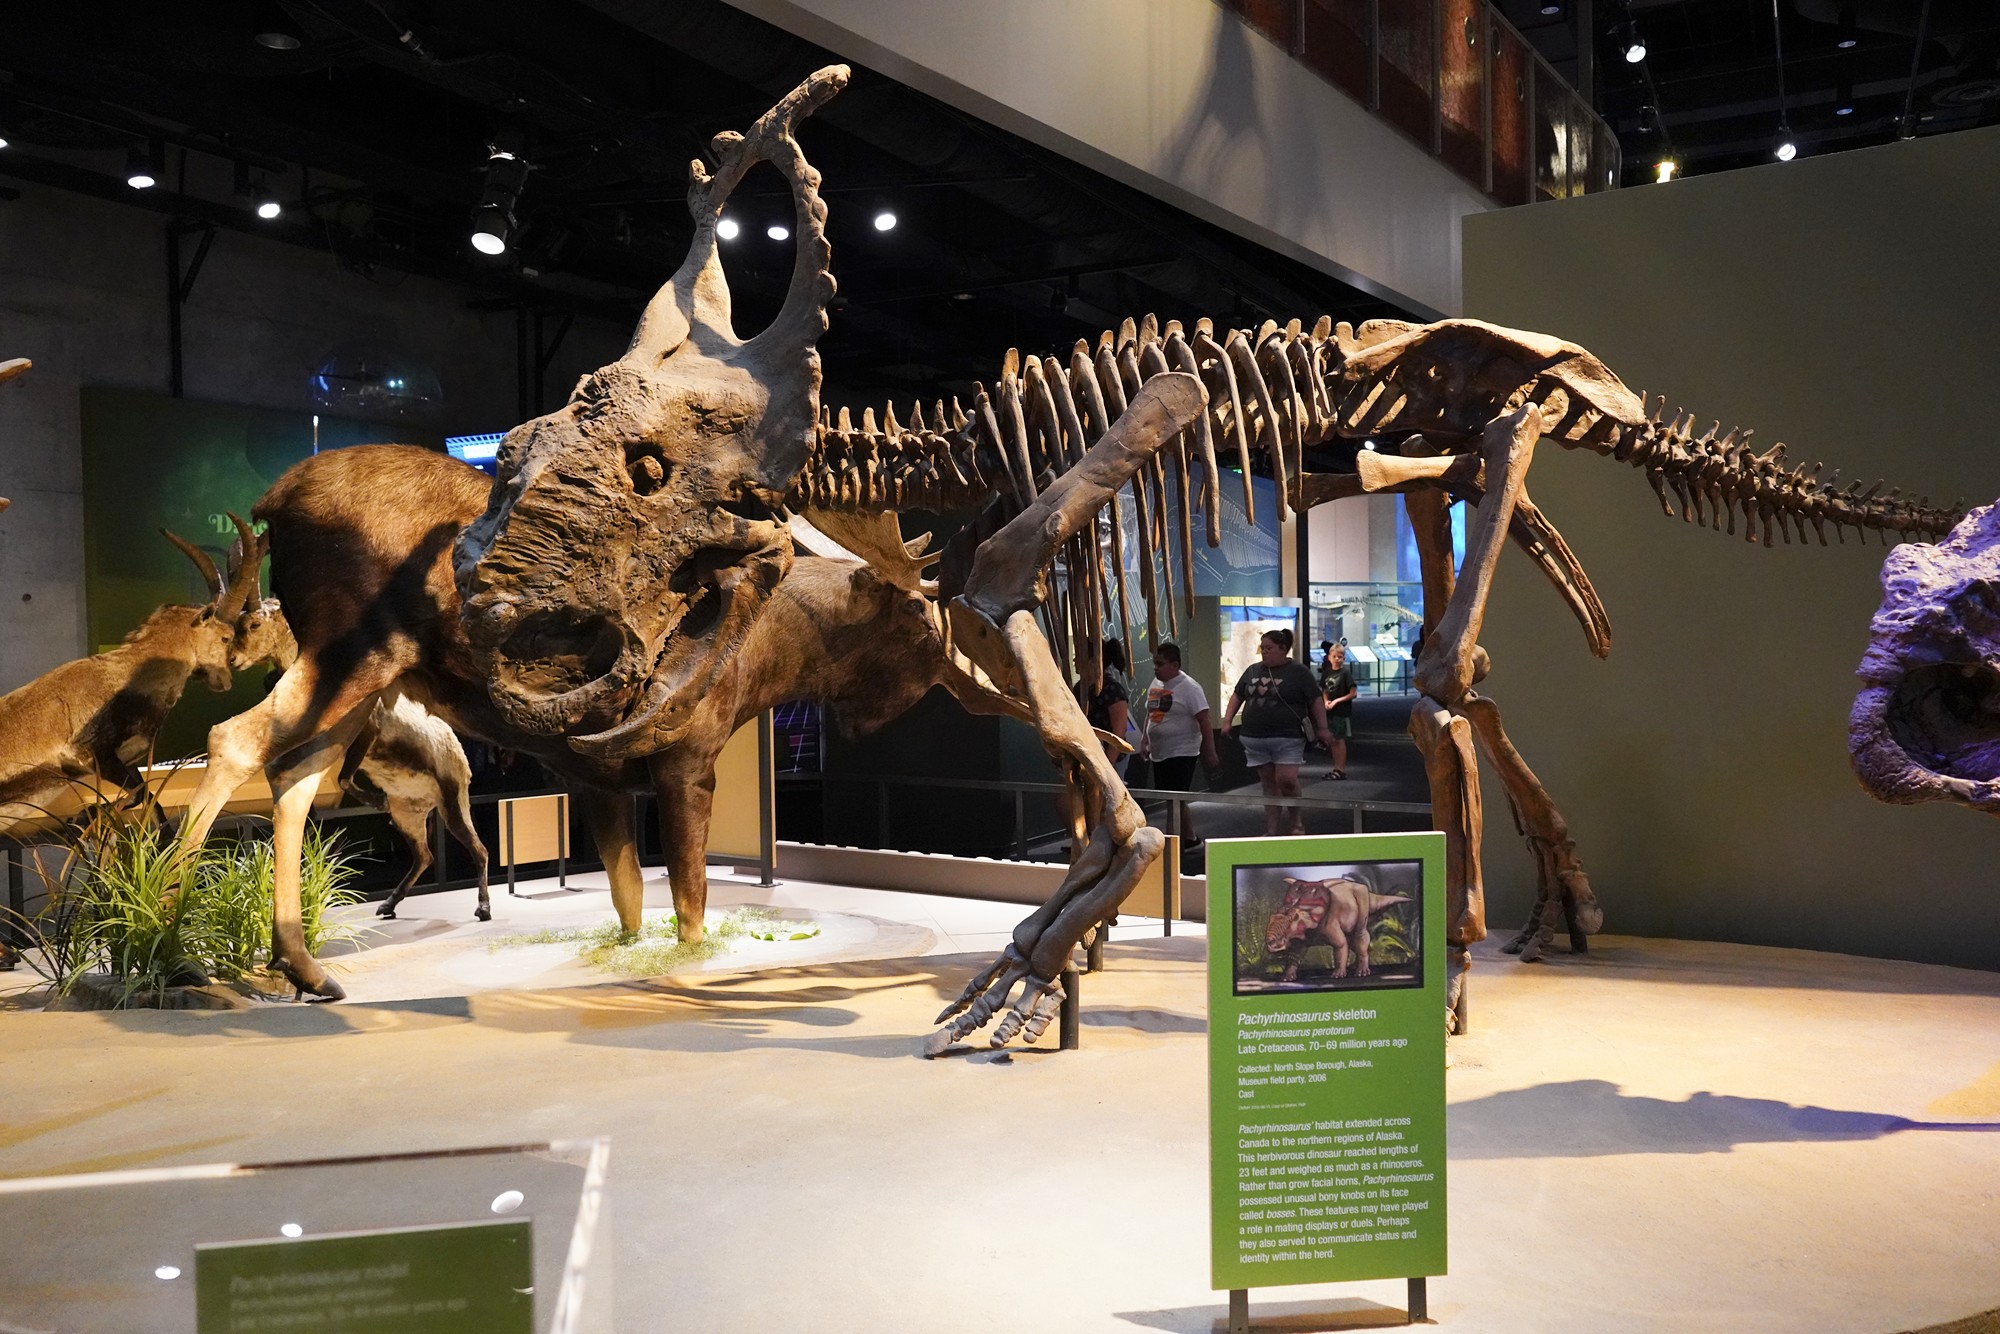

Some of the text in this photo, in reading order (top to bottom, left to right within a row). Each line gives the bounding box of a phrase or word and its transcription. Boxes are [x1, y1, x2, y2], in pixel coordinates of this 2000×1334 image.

[1238, 1008, 1376, 1026] Pachyrhinosaurus skeleton
[1238, 1026, 1354, 1039] Pachyrhinosaurus perotorum
[1238, 1043, 1256, 1054] Late
[1258, 1041, 1305, 1053] Cretaceous,
[1339, 1038, 1366, 1049] million
[1368, 1039, 1390, 1049] years
[1392, 1038, 1407, 1048] ago
[1273, 1063, 1293, 1071] North
[1237, 1076, 1268, 1086] Museum
[1269, 1075, 1286, 1084] field
[1307, 1073, 1327, 1082] 2006
[1237, 1088, 1256, 1098] Cast
[1314, 1119, 1343, 1130] habitat
[1344, 1117, 1382, 1128] extended
[1383, 1117, 1411, 1126] across
[1238, 1130, 1404, 1148] Canada to the northern regions of Alaska.
[1237, 1144, 1418, 1163] This herbivorous dinosaur reached lengths of
[1239, 1167, 1249, 1177] 23
[1252, 1166, 1267, 1176] feet
[1269, 1166, 1285, 1175] and
[1287, 1163, 1321, 1176] weighed
[1324, 1164, 1334, 1172] as
[1335, 1162, 1358, 1171] much
[1361, 1162, 1370, 1170] as
[1380, 1158, 1424, 1169] rhinoceros.
[1239, 1180, 1266, 1191] Rather
[1268, 1180, 1287, 1190] than
[1288, 1180, 1309, 1190] grow
[1311, 1177, 1333, 1187] facial
[1363, 1171, 1434, 1184] Pachyrhinosaurus
[1239, 1187, 1408, 1206] possessed unusual bony knobs on its face
[1239, 1200, 1428, 1220] called bosses. These features may have played
[1239, 1215, 1409, 1234] a role in mating displays or duels. Perhaps
[1239, 1229, 1416, 1250] they also served to communicate status and
[1239, 1248, 1334, 1264] identity within the herd.
